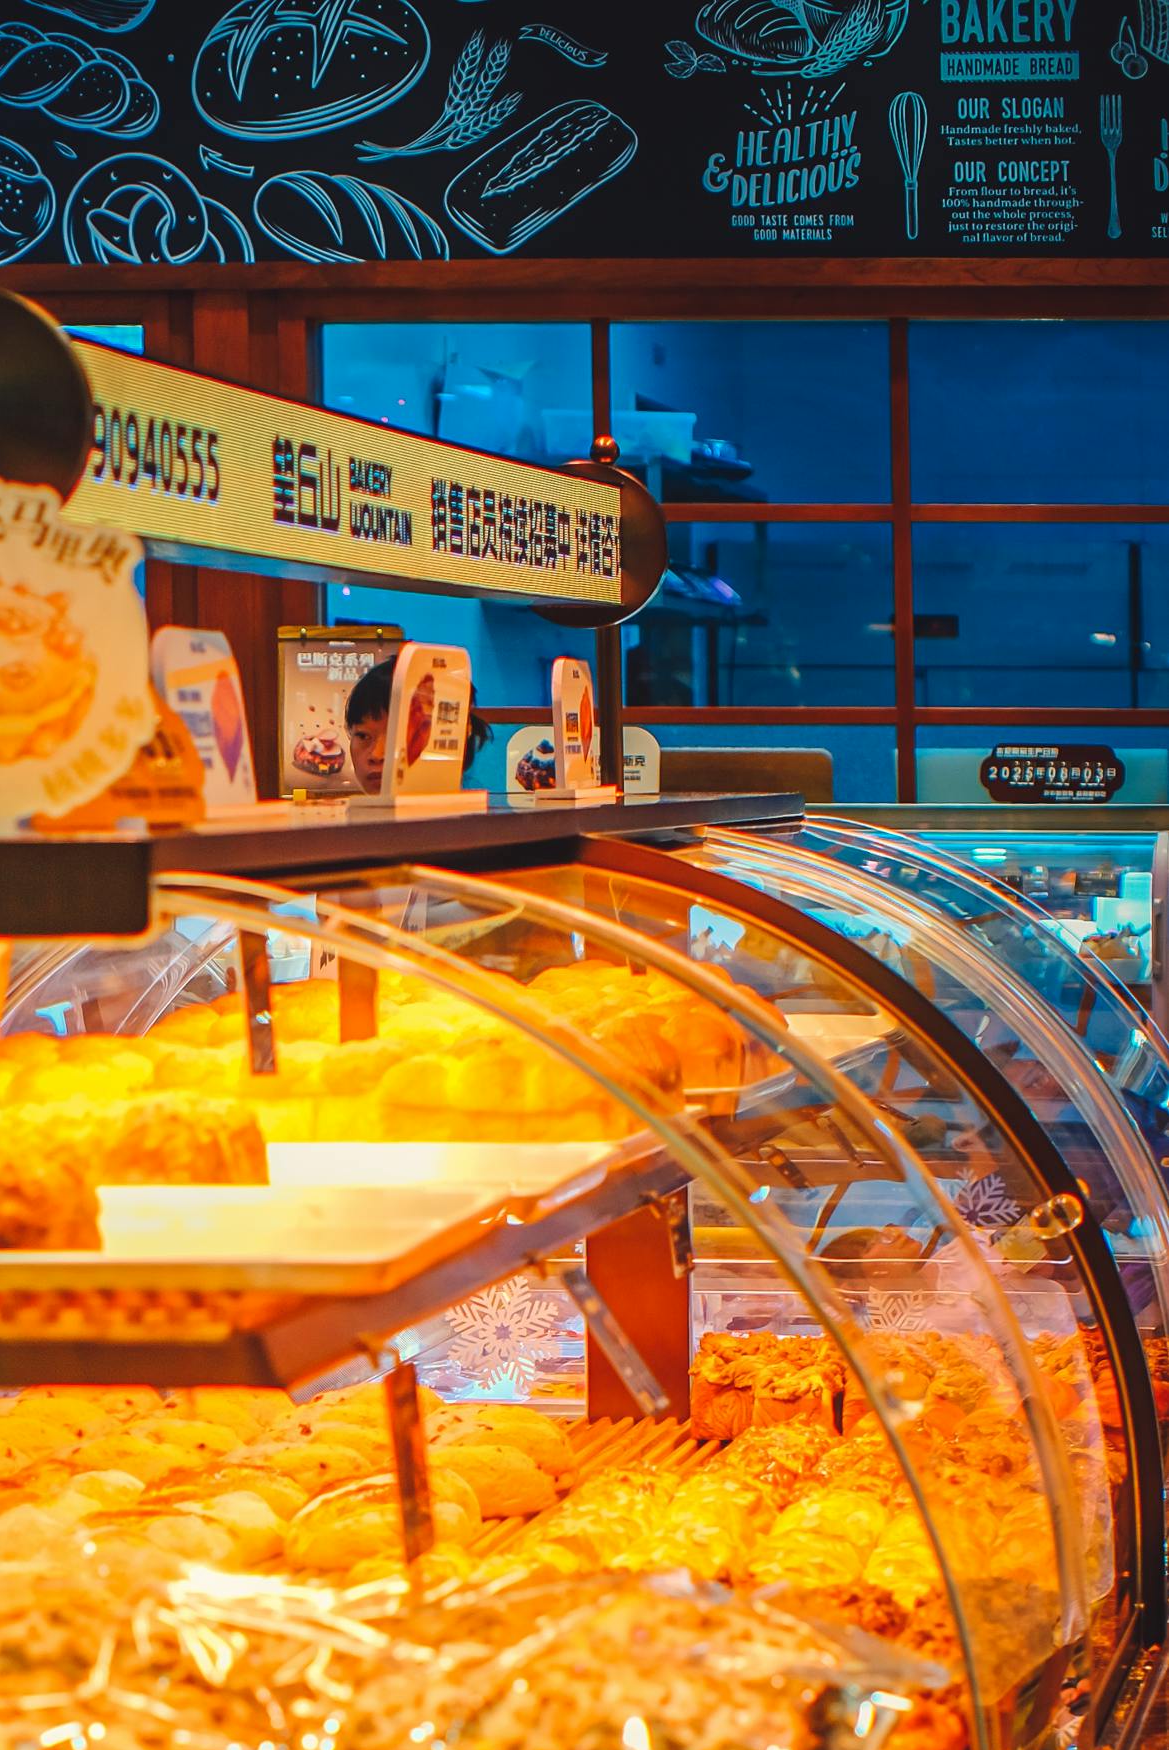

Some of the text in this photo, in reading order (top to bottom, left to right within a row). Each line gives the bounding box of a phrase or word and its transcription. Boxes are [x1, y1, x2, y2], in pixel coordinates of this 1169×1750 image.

[941, 0, 1077, 44] BAKERY
[947, 57, 1073, 76] HANDMADE BREAD
[958, 97, 1064, 119] OUR SLOGAN
[941, 122, 1082, 136] Handmade freshly baked,
[736, 111, 857, 167] HEALTHY
[947, 136, 983, 146] Tastes
[985, 136, 1019, 146] better
[1021, 136, 1052, 145] when
[731, 151, 862, 207] DELICIOUS
[954, 160, 1070, 182] OUR CONCEPT
[949, 185, 1077, 197] From flour to bread, it's
[942, 197, 1084, 210] 100% handmade through-
[731, 213, 855, 227] GOOD TASTE COMES FROM
[951, 209, 1075, 221] out the whole process,
[753, 227, 833, 241] GOOD MATERIALS
[948, 221, 969, 232] just
[971, 221, 983, 231] to
[985, 221, 1025, 231] restore
[1027, 221, 1046, 231] the
[962, 231, 1066, 243] nal flavor of bread.
[93, 404, 220, 506] 90940555
[349, 456, 392, 499] BAKERY
[350, 501, 413, 546] WOUNTAIN
[296, 651, 376, 672] 巴斯克系列
